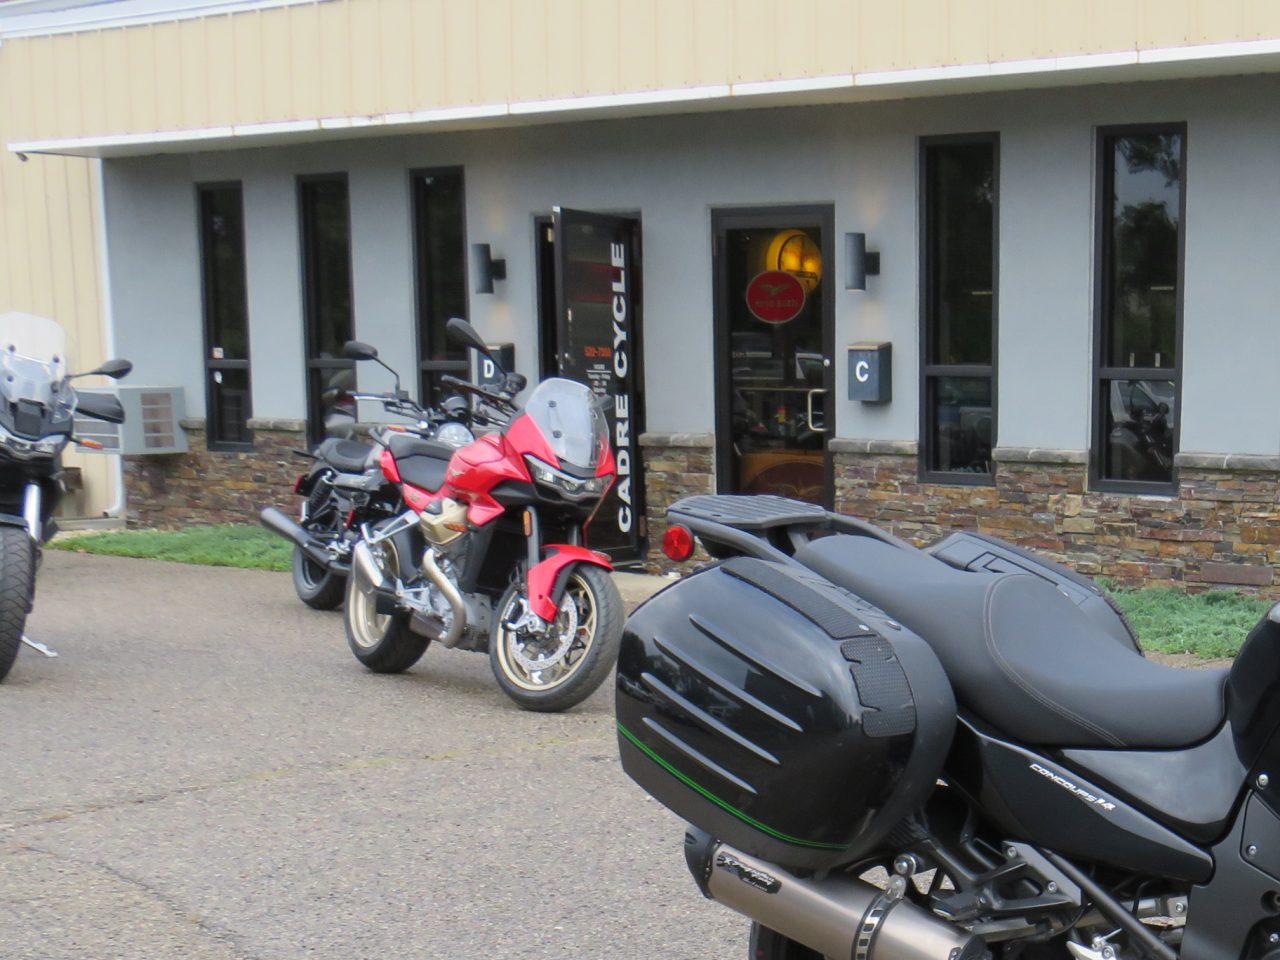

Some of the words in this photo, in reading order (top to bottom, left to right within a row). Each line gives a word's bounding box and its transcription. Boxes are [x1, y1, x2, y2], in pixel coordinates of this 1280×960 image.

[610, 242, 628, 378] CYCLE
[483, 359, 495, 378] D
[855, 360, 869, 382] C
[615, 394, 632, 533] CADRE
